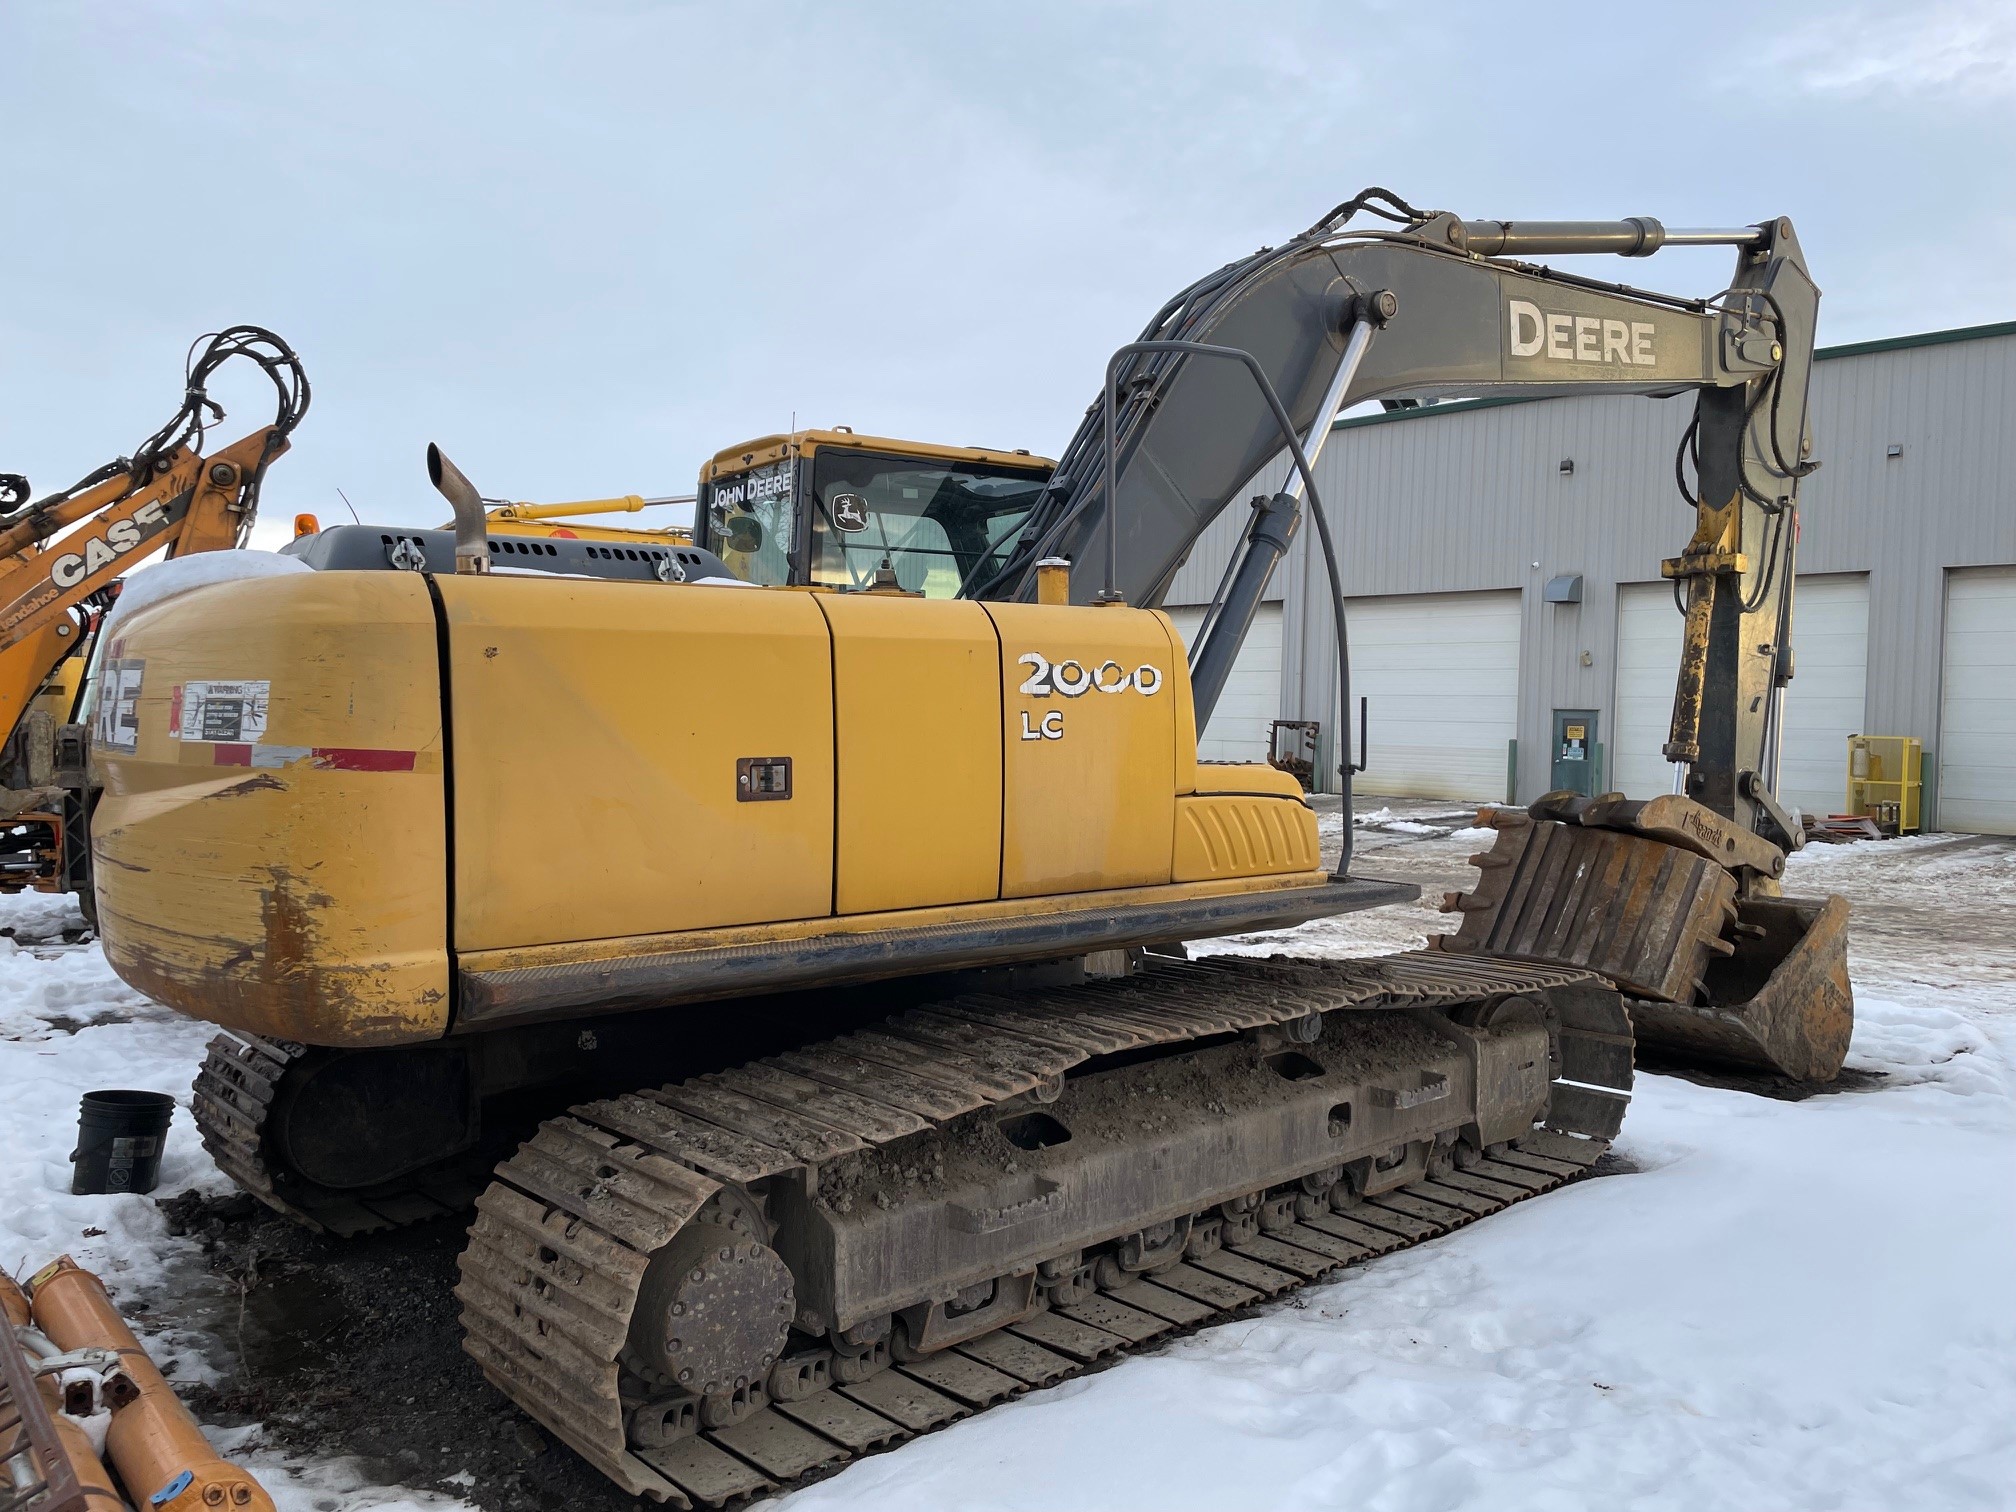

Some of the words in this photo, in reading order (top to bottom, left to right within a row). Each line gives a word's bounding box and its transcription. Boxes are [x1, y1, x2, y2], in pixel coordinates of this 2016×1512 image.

[1510, 300, 1656, 366] DEERE
[711, 485, 744, 509] JOHN
[747, 472, 791, 500] DEERE
[51, 499, 170, 588] CASE
[93, 669, 143, 746] RE
[1021, 711, 1063, 741] LC
